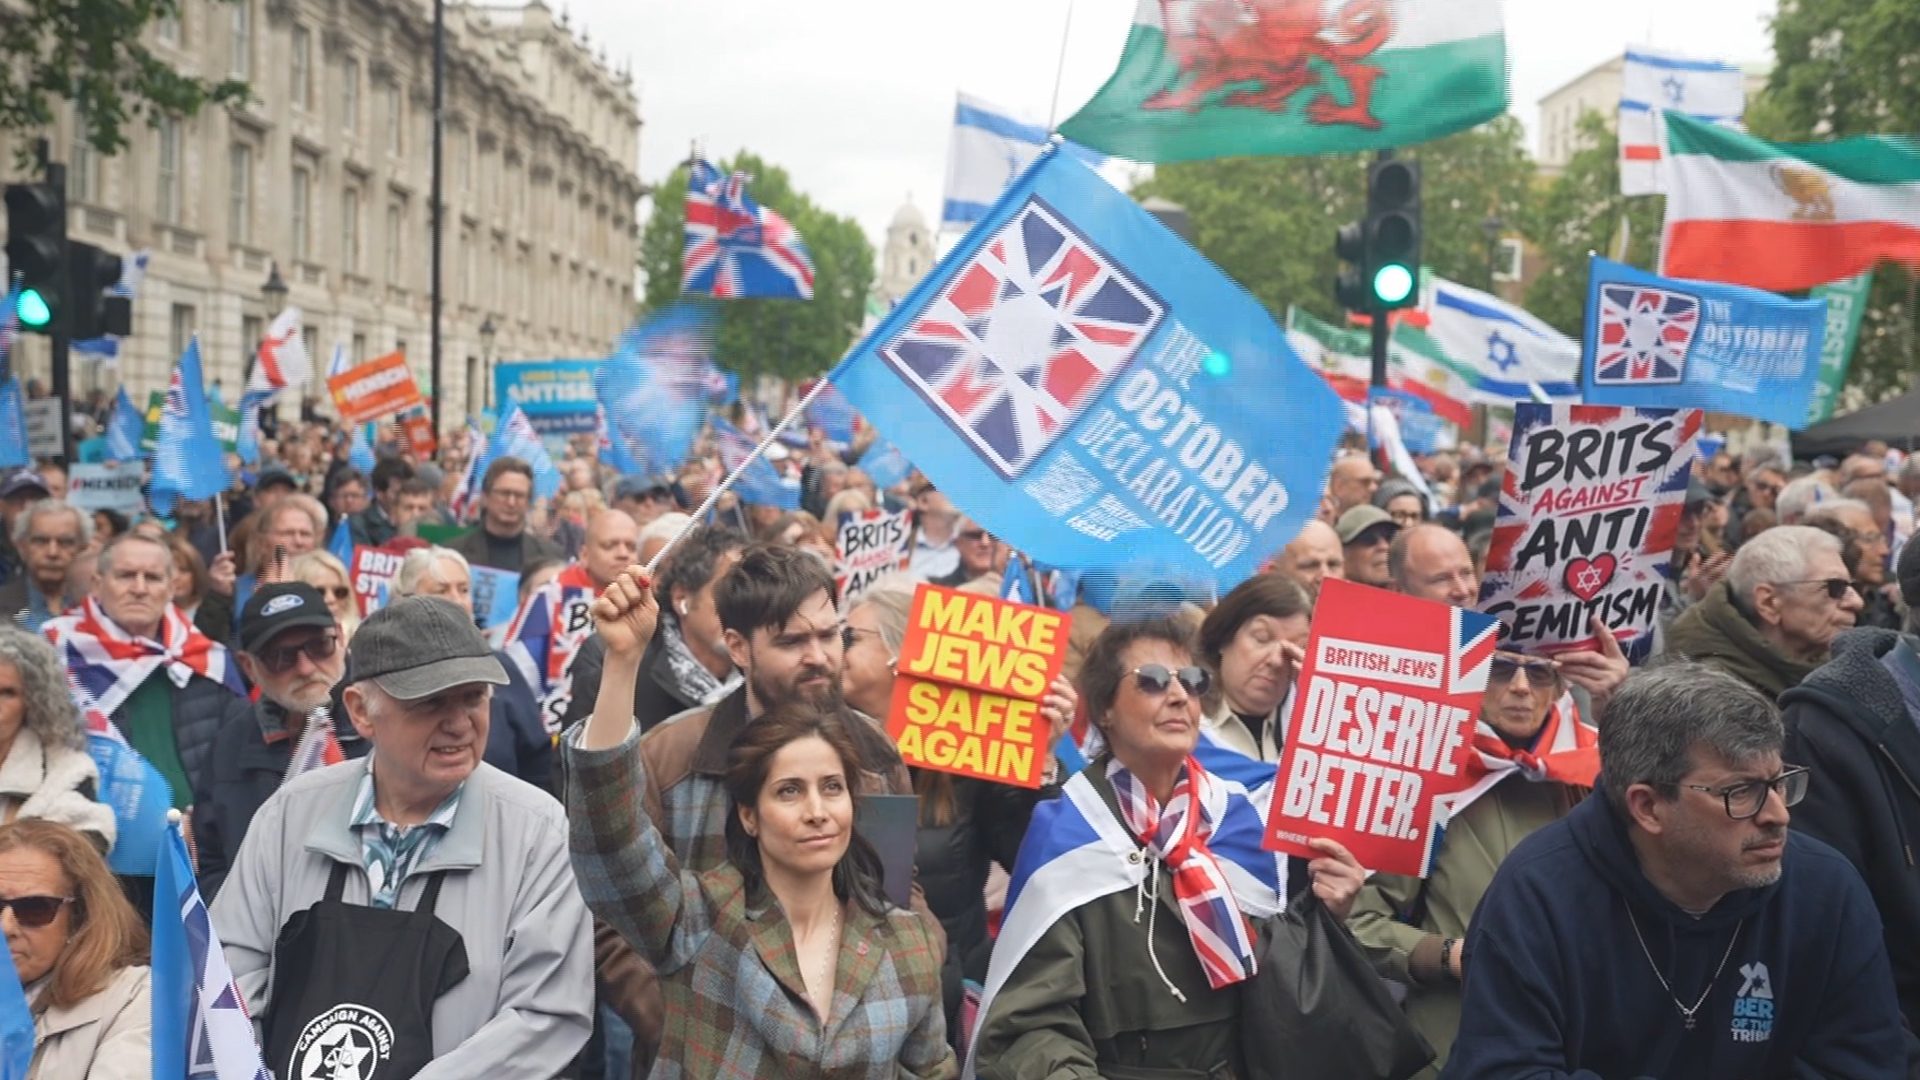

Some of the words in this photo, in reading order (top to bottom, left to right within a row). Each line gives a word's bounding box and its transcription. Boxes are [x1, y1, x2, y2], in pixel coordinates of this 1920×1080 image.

[1151, 320, 1214, 390] THE
[1115, 368, 1289, 532] OCTOBER
[1520, 420, 1674, 491] BRITS
[1076, 408, 1250, 569] DECLARATION
[1531, 475, 1649, 516] AGAINST
[845, 518, 902, 558] BRITS
[1513, 506, 1651, 571] ANTI
[919, 590, 1061, 655] MAKE
[1484, 583, 1659, 642] SEMITISM
[909, 632, 1048, 696] JEWS
[1323, 646, 1391, 673] BRITISH
[1392, 657, 1439, 680] JEWS
[905, 682, 1038, 744] SAFE
[1298, 675, 1471, 776] DESERVE
[896, 724, 1034, 782] AGAIN
[1281, 747, 1423, 842] BETTER.
[299, 1010, 359, 1052] CAMPAIGN
[359, 1014, 391, 1060] AGAINST
[1733, 998, 1774, 1019] BER
